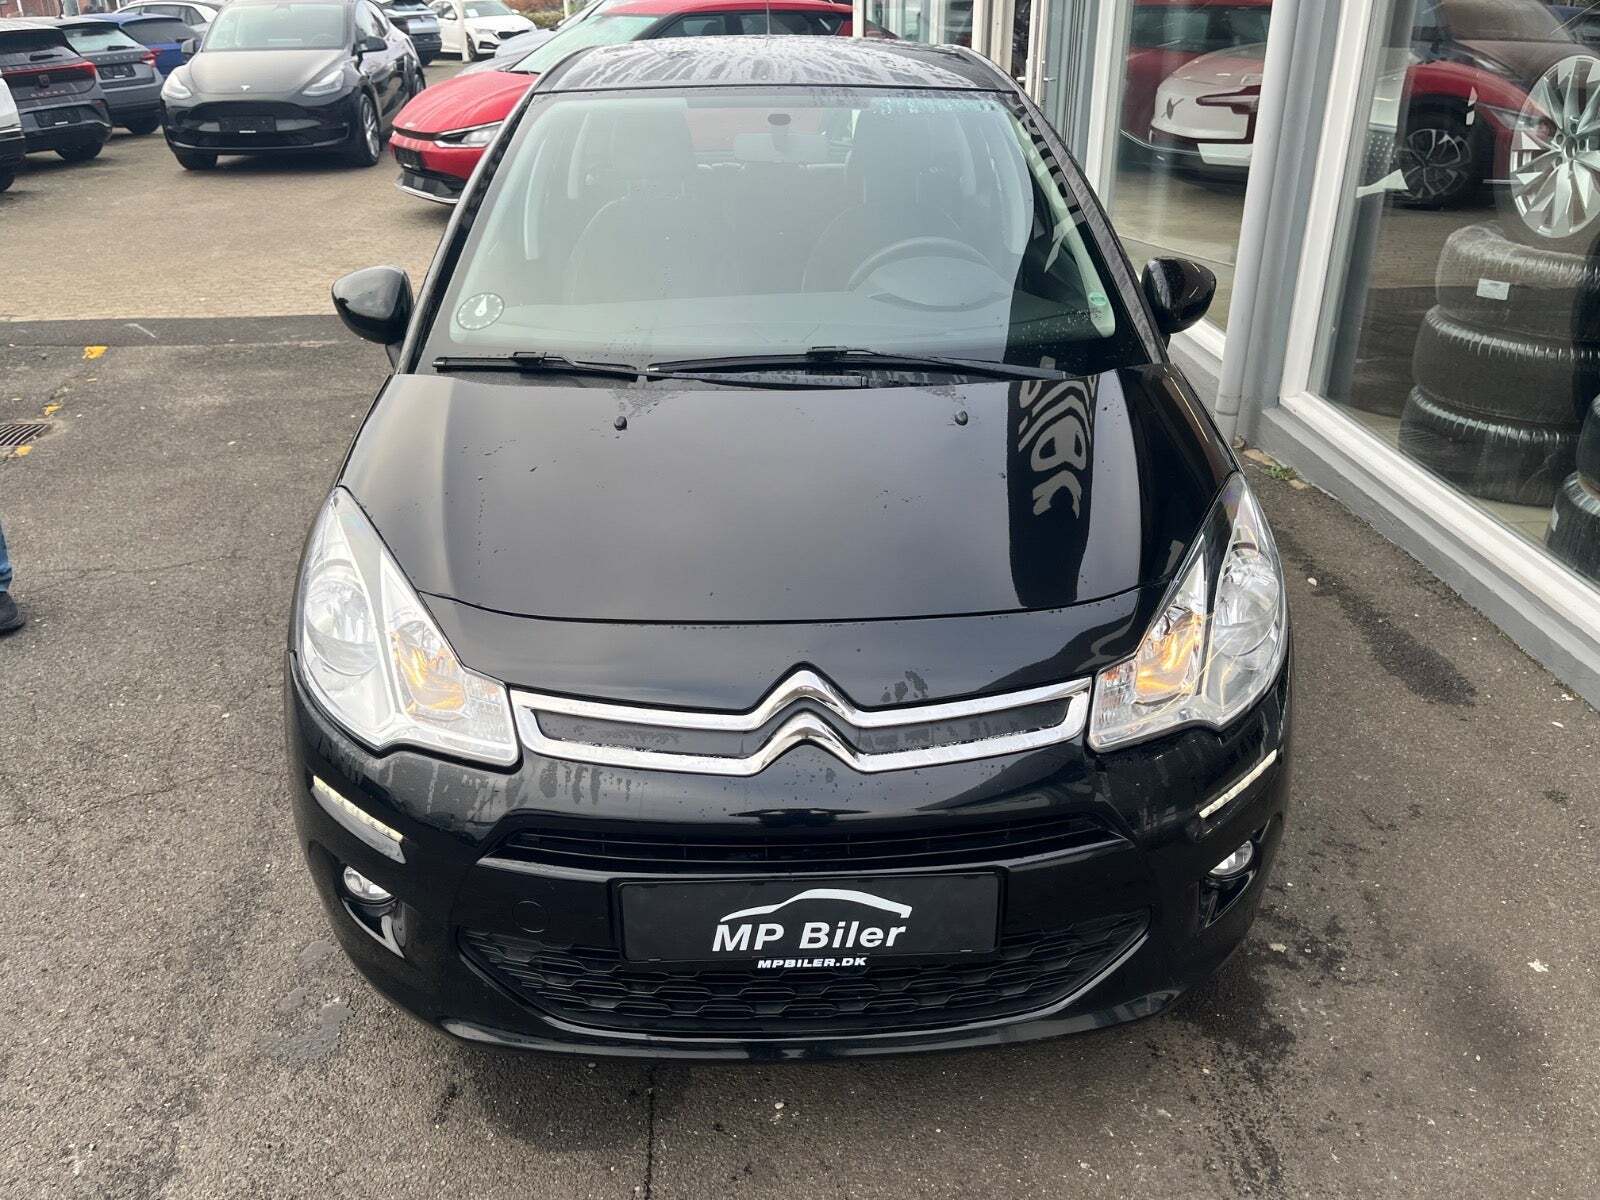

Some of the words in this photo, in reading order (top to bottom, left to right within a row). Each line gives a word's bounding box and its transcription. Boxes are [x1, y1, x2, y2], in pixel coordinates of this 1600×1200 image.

[711, 923, 785, 952] MP
[798, 920, 907, 949] Biler
[757, 956, 868, 969] MPBILER.DK
